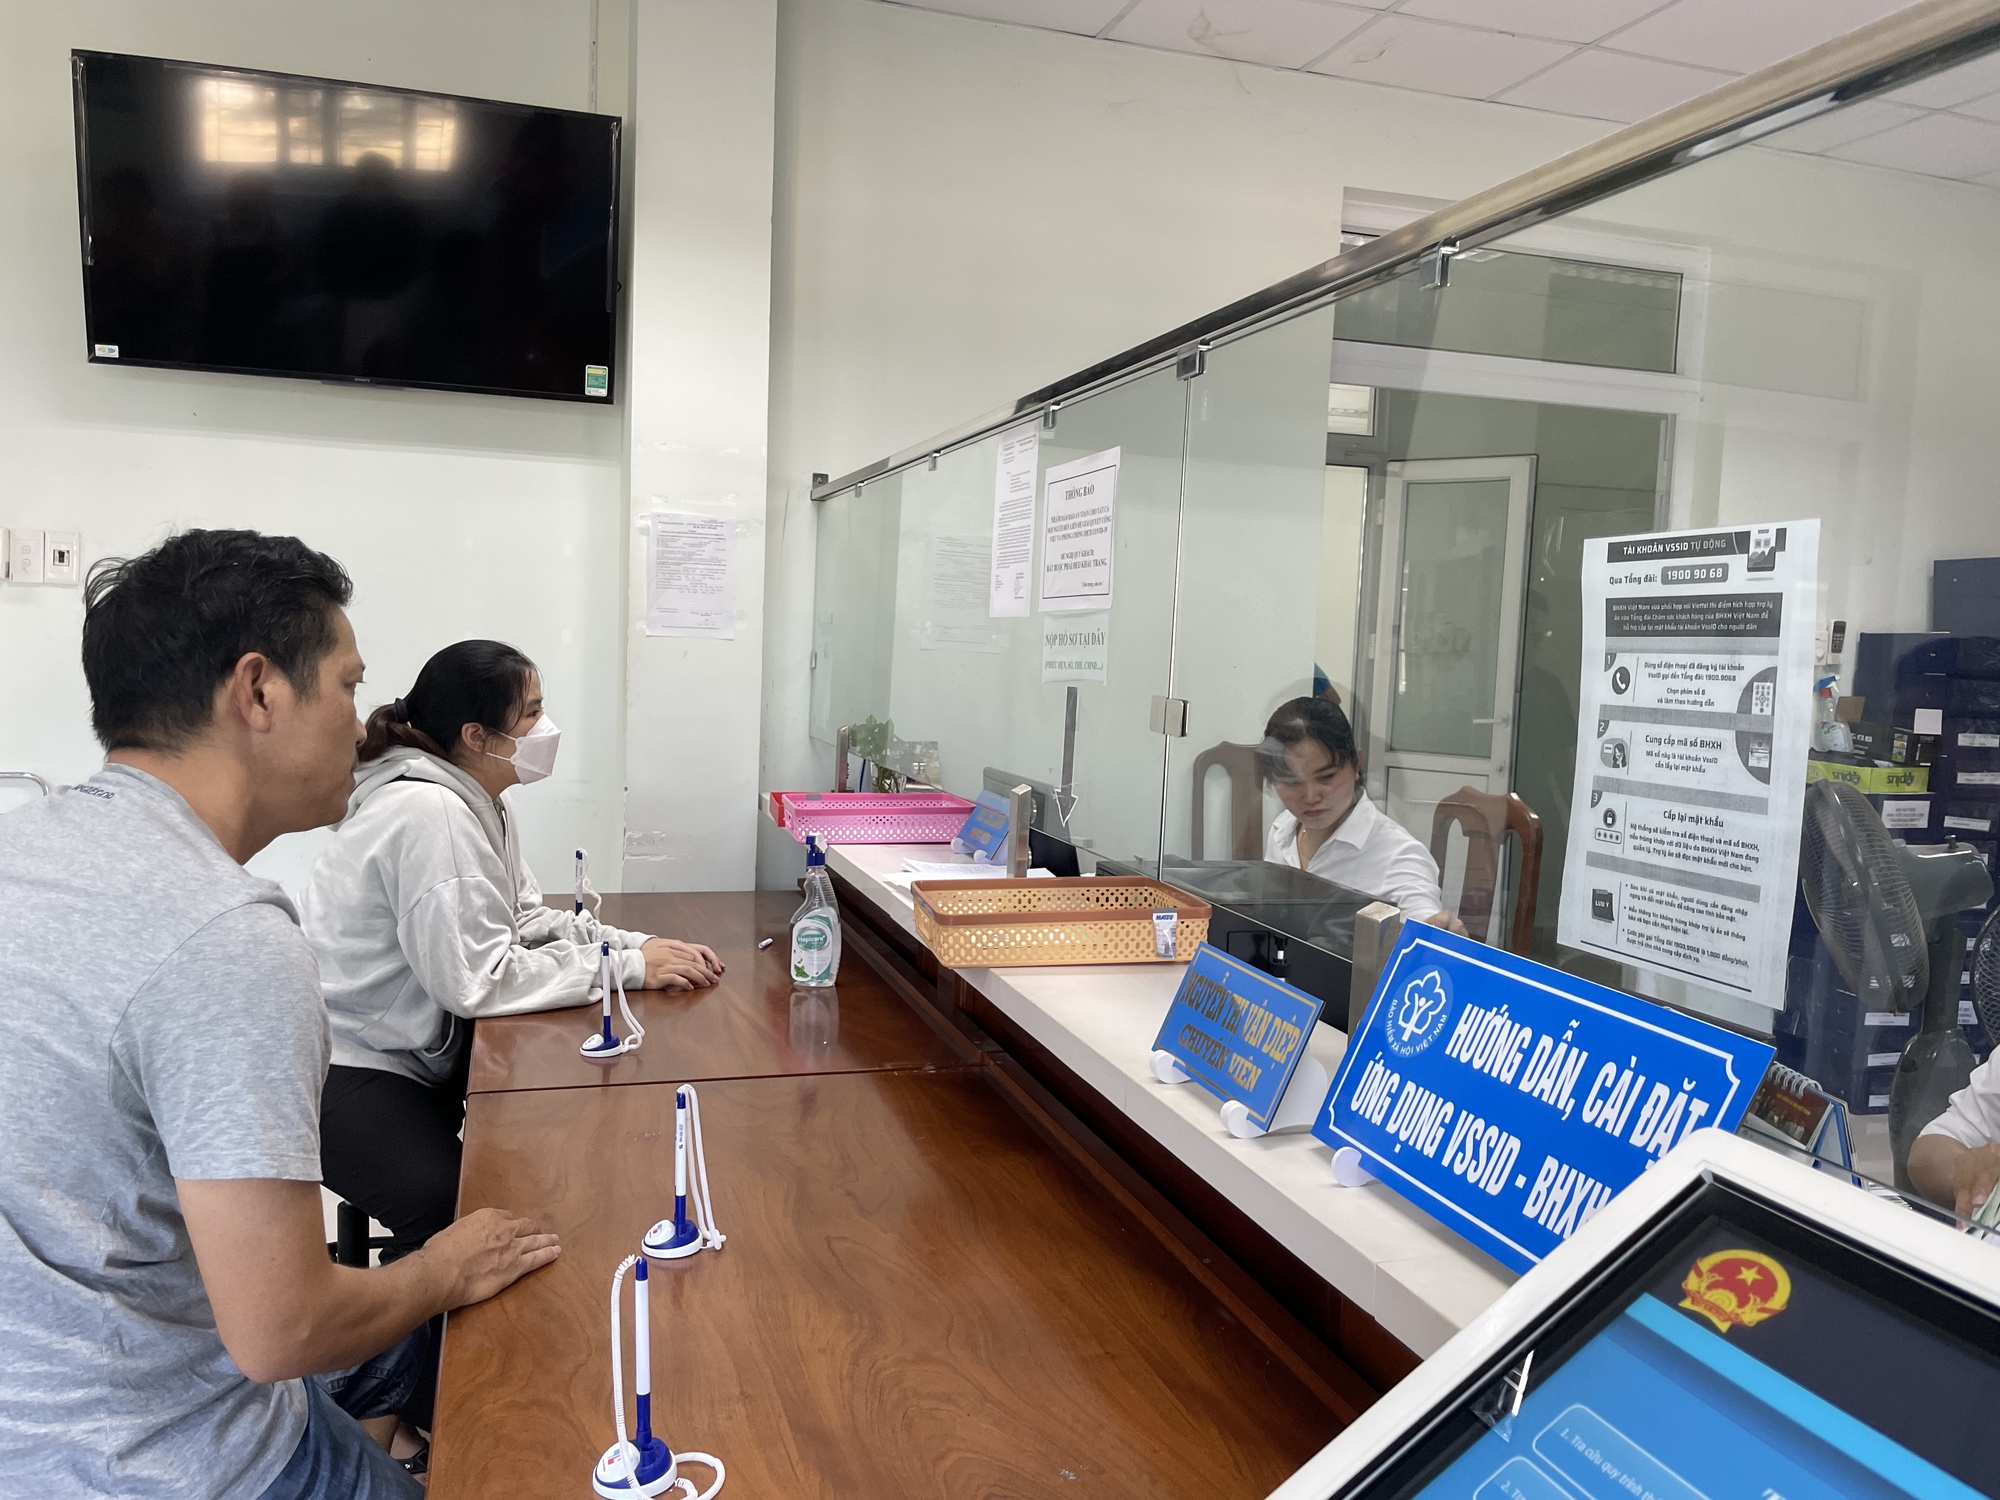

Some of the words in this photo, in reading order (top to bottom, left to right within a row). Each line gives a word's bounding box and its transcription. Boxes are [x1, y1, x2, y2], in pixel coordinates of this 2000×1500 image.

[1623, 545, 1635, 555] TÀI
[1637, 542, 1663, 554] KHOẢN
[1666, 542, 1688, 552] VSSID
[1691, 540, 1701, 552] TỰ
[1702, 538, 1726, 550] ĐỘNG
[1609, 576, 1622, 585] Qua
[1624, 572, 1642, 585] Tổng
[1644, 574, 1658, 582] đài:
[1668, 570, 1690, 580] 1900
[1694, 569, 1706, 579] 90
[1709, 568, 1723, 578] 68
[1045, 632, 1057, 649] NỘP
[1058, 629, 1068, 646] HỒ
[1069, 632, 1078, 646] SƠ
[1079, 633, 1090, 649] TẠI
[1091, 628, 1106, 646] ĐÂY
[1607, 656, 1611, 664] 1
[1600, 723, 1604, 732] 2
[1645, 734, 1662, 745] Cung
[1663, 735, 1675, 747] cấp
[1677, 738, 1688, 746] mã
[1690, 737, 1698, 748] số
[1700, 740, 1722, 750] BHXH
[1593, 793, 1598, 802] 3
[1664, 809, 1676, 821] Cấp
[1678, 812, 1687, 823] lại
[1688, 815, 1703, 826] mật
[1704, 816, 1724, 827] khẩu
[1181, 971, 1231, 1023] NGUYỄN
[1221, 993, 1250, 1043] THỊ
[1241, 999, 1274, 1048] VÂN
[1262, 1015, 1300, 1070] DIỆP
[1179, 1023, 1231, 1071] CHUYÊN
[1227, 1052, 1262, 1092] VIÊN
[1445, 1003, 1532, 1085] HƯỚNG
[1518, 1019, 1588, 1121] DẪN,
[1582, 1055, 1646, 1138] CÀI
[1629, 1077, 1710, 1170] ĐẶT
[1350, 1051, 1400, 1126] ỨNG
[1385, 1080, 1454, 1158] DỤNG
[1441, 1109, 1521, 1196] VSSID
[1515, 1173, 1527, 1189] -
[1560, 1429, 1569, 1440] 1.
[1571, 1434, 1586, 1451] Tra
[1602, 1462, 1621, 1479] quy
[1500, 1480, 1510, 1493] 2.
